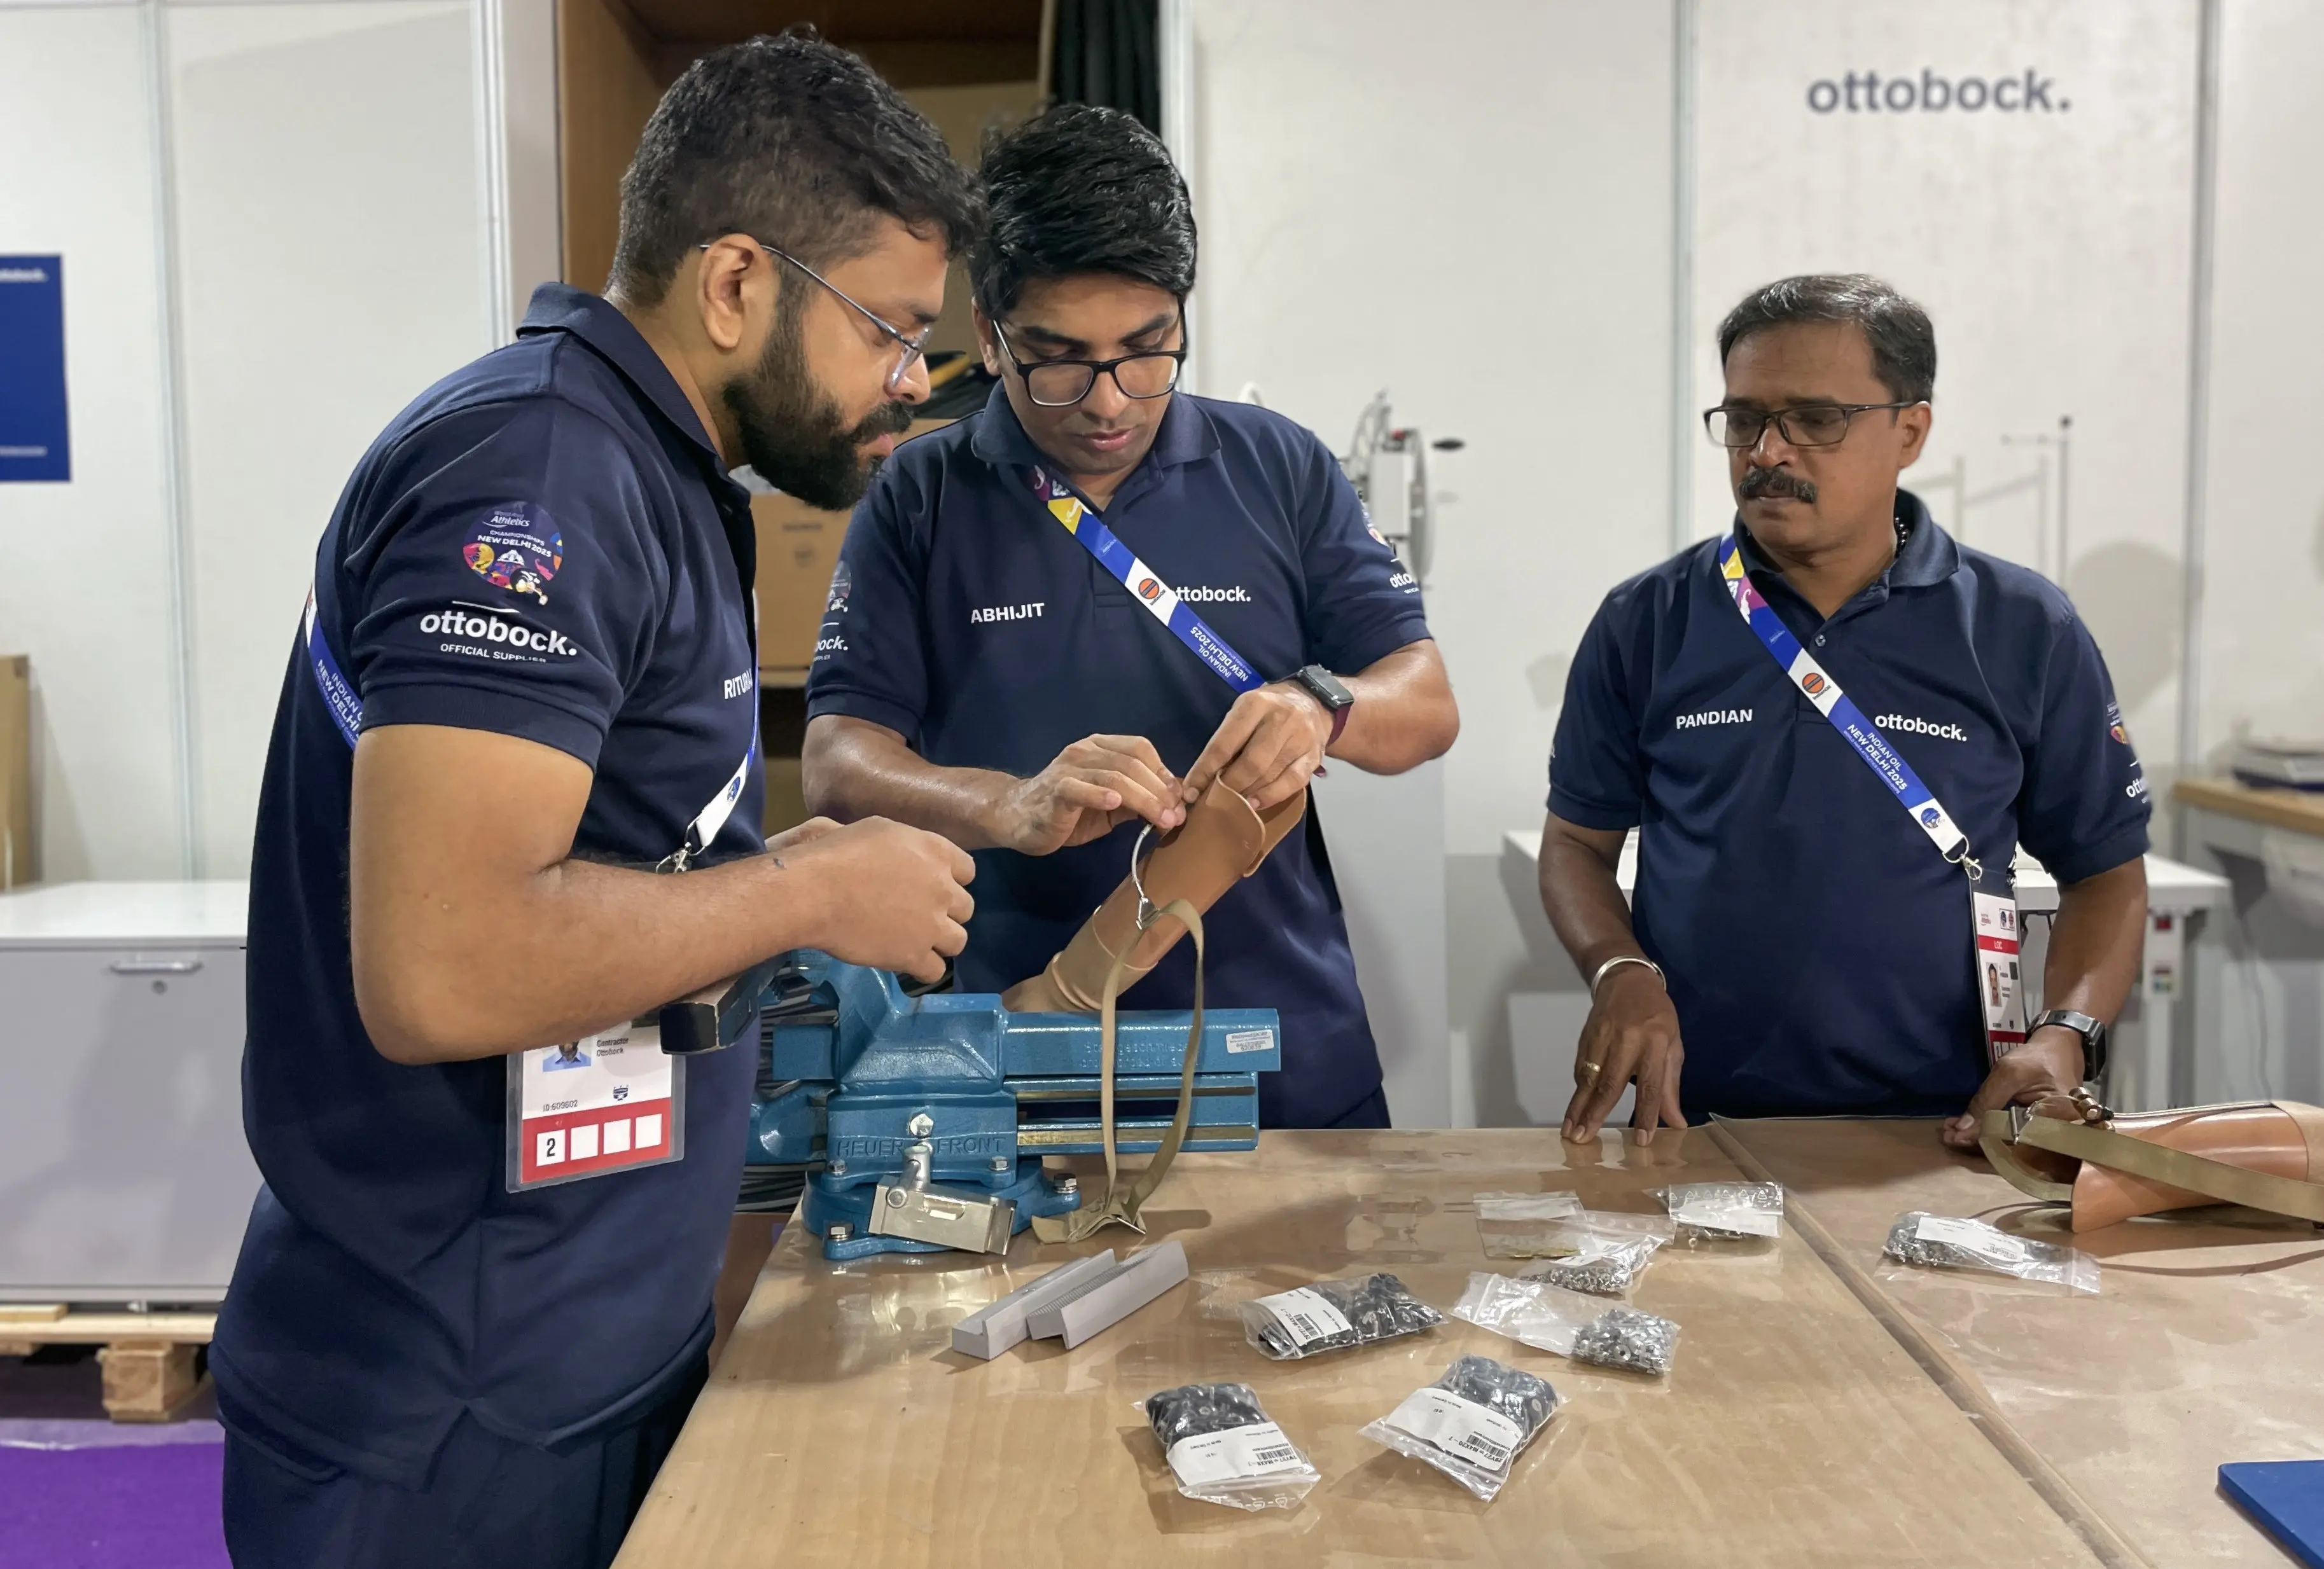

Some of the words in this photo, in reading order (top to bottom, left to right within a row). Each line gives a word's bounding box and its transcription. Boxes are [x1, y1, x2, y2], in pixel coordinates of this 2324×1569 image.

[1806, 67, 2072, 114] ottobock.
[491, 516, 531, 527] Athletics
[477, 535, 501, 544] NEW
[502, 538, 531, 548] DELHI
[531, 544, 552, 558] 2025
[490, 530, 545, 546] CHAMPIONSHIPS
[1172, 586, 1251, 602] ttobock.
[971, 602, 1045, 624] ABHIJIT
[420, 611, 577, 656] ottobock.
[1190, 626, 1211, 646] 2025
[440, 643, 490, 658] OFFICIAL
[492, 651, 546, 663] SUPPLIER
[1197, 645, 1209, 658] OIL
[1208, 643, 1232, 666] DELHI
[1208, 655, 1232, 677] INDIAN
[1230, 663, 1249, 681] NEW
[317, 659, 335, 691] NEW
[331, 693, 361, 732] DELHI
[331, 672, 359, 713] INDIAN
[1676, 708, 1753, 729] PANDIAN
[1874, 714, 1967, 742] ottobock.
[1847, 724, 1869, 745] NEW
[1866, 744, 1890, 771] DELHI
[1888, 769, 1907, 791] 2025
[1867, 732, 1892, 759] INDIAN
[1889, 757, 1902, 771] OIL
[546, 1138, 555, 1158] 2
[837, 1138, 903, 1156] HEUER
[937, 1137, 1006, 1153] FRONT
